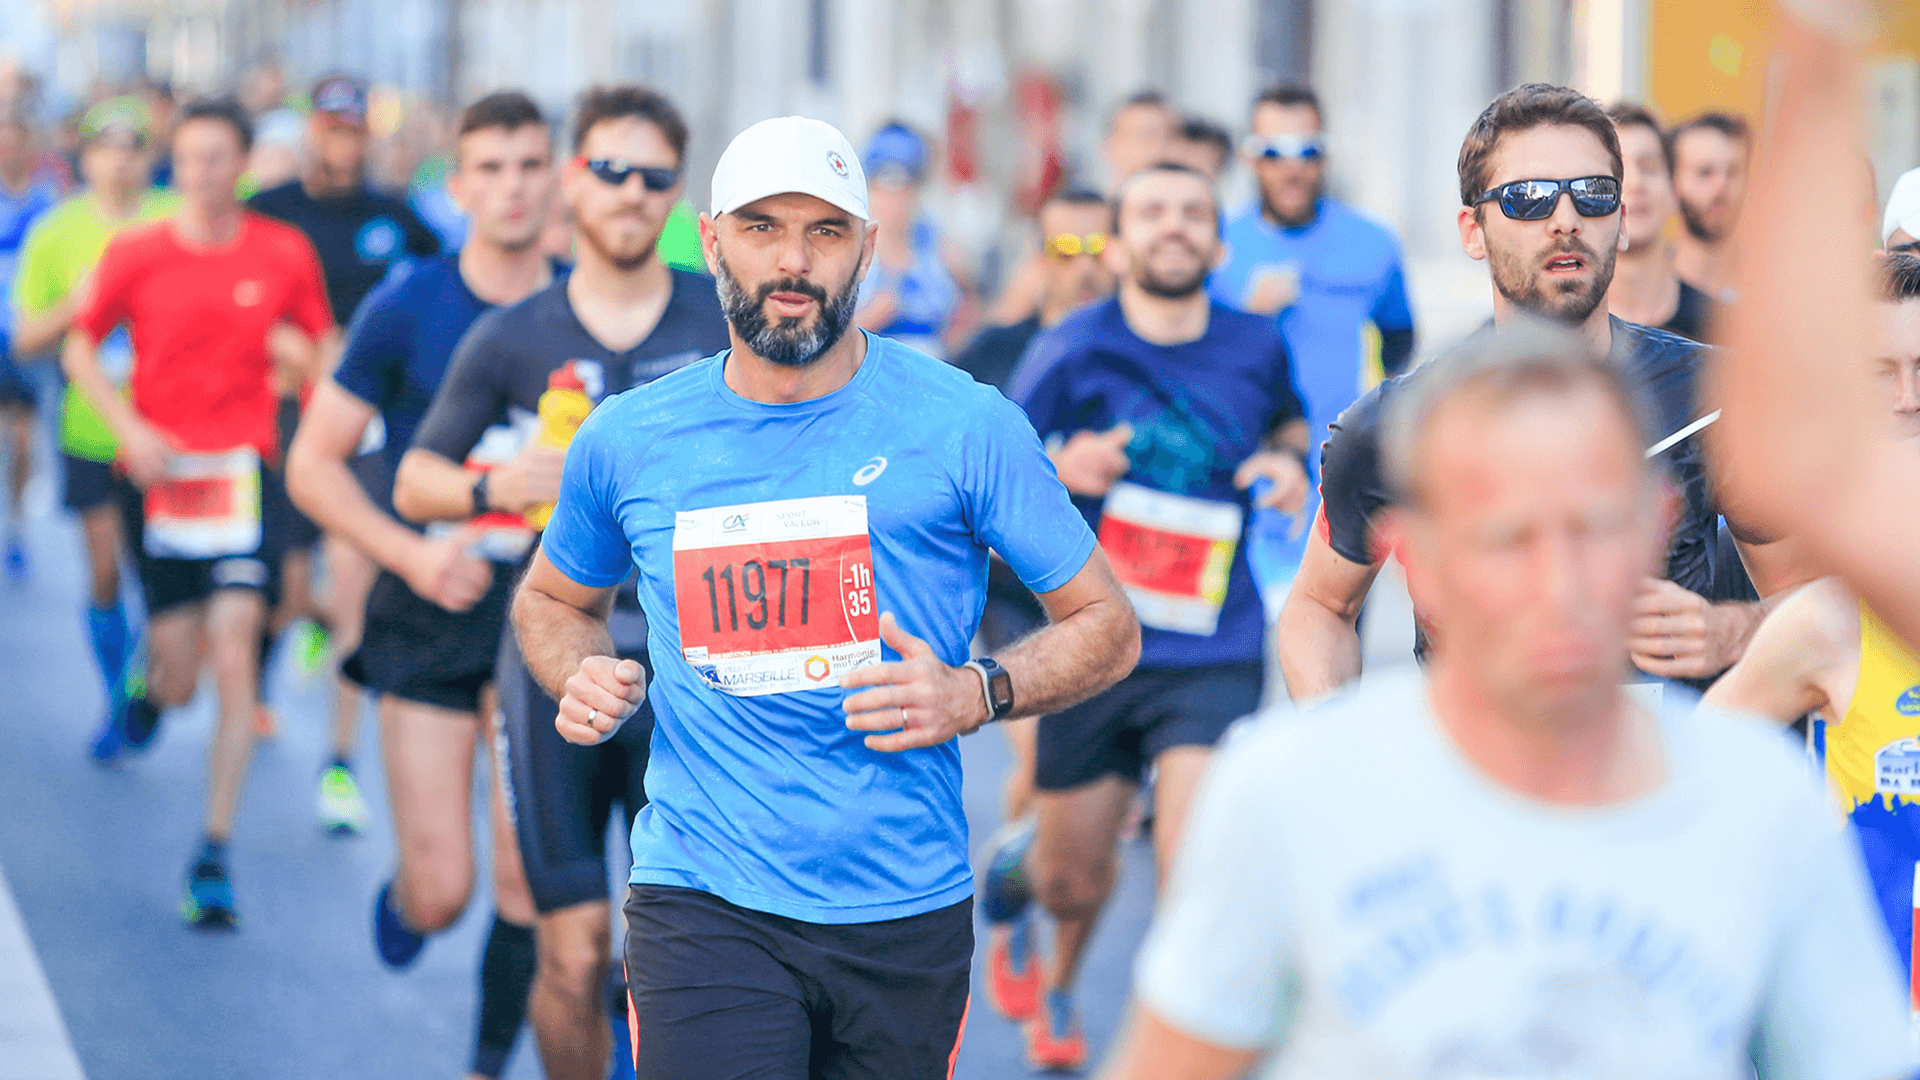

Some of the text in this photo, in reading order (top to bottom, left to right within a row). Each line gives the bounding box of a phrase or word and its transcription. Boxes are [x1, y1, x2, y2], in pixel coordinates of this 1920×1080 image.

[783, 518, 820, 529] VALEUR
[843, 562, 871, 589] -1h
[702, 557, 810, 633] 11977
[848, 588, 871, 617] 35
[832, 648, 875, 662] Harmonie
[723, 668, 796, 686] MARSEILLE
